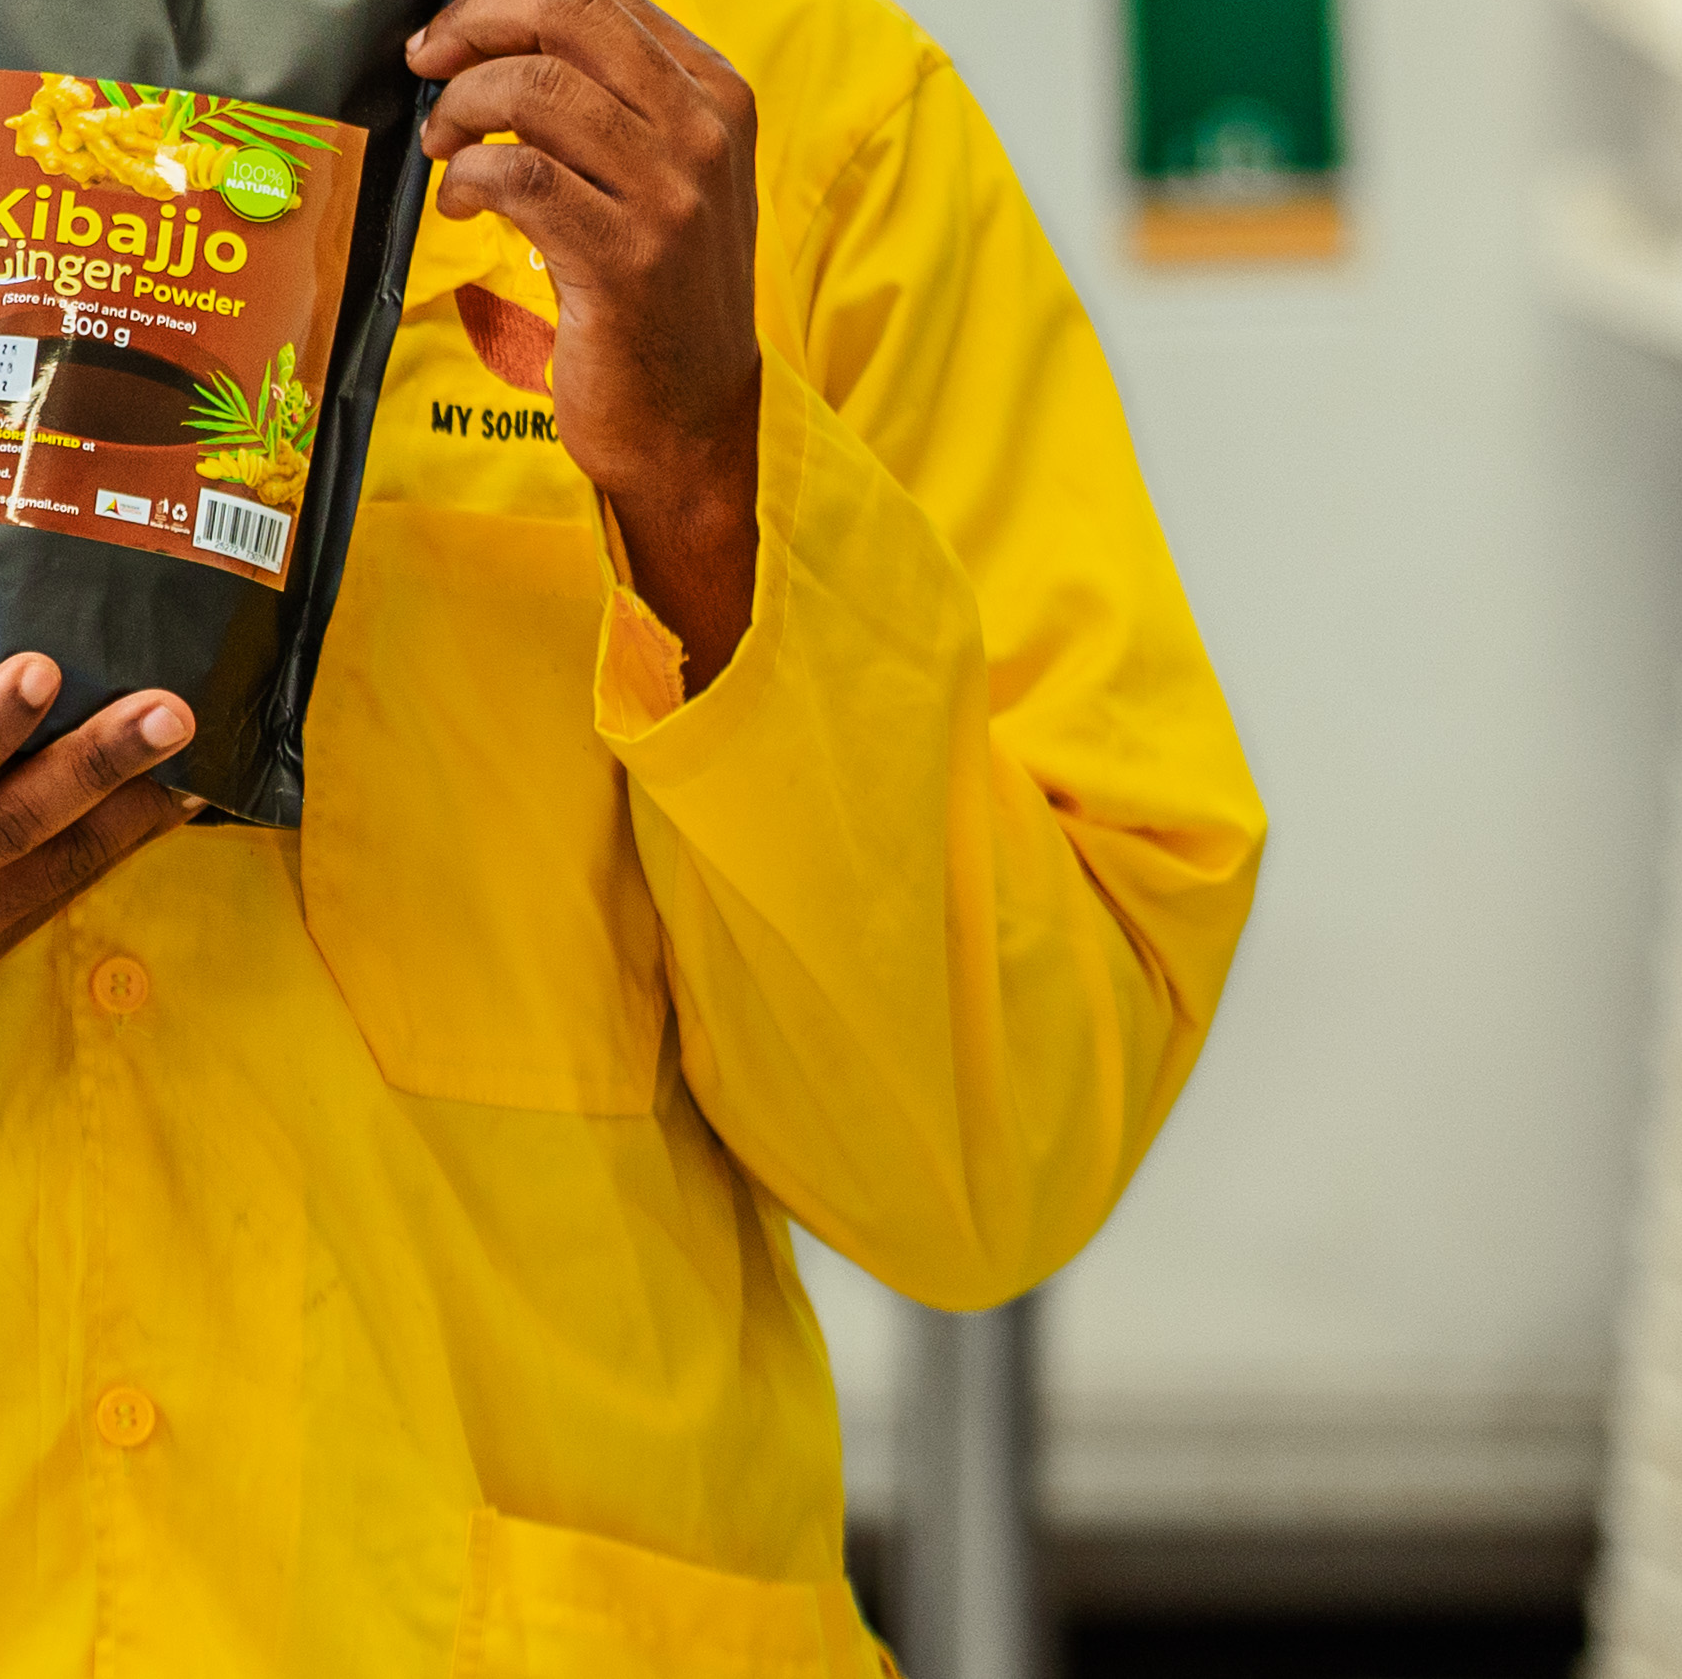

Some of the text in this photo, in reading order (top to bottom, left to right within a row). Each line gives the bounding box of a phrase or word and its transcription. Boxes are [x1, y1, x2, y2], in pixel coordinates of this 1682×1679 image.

[226, 177, 287, 199] NATURAL
[233, 161, 283, 186] 100%
[2, 292, 39, 306] (Store
[42, 293, 56, 307] in
[68, 300, 99, 315] cool
[101, 303, 127, 320] and
[129, 309, 154, 328] Dry
[156, 315, 197, 335] Place)
[133, 275, 246, 318] Powder
[60, 313, 131, 349] 500 g
[432, 401, 473, 437] MY
[31, 432, 80, 449] LIMITED
[82, 441, 96, 453] at
